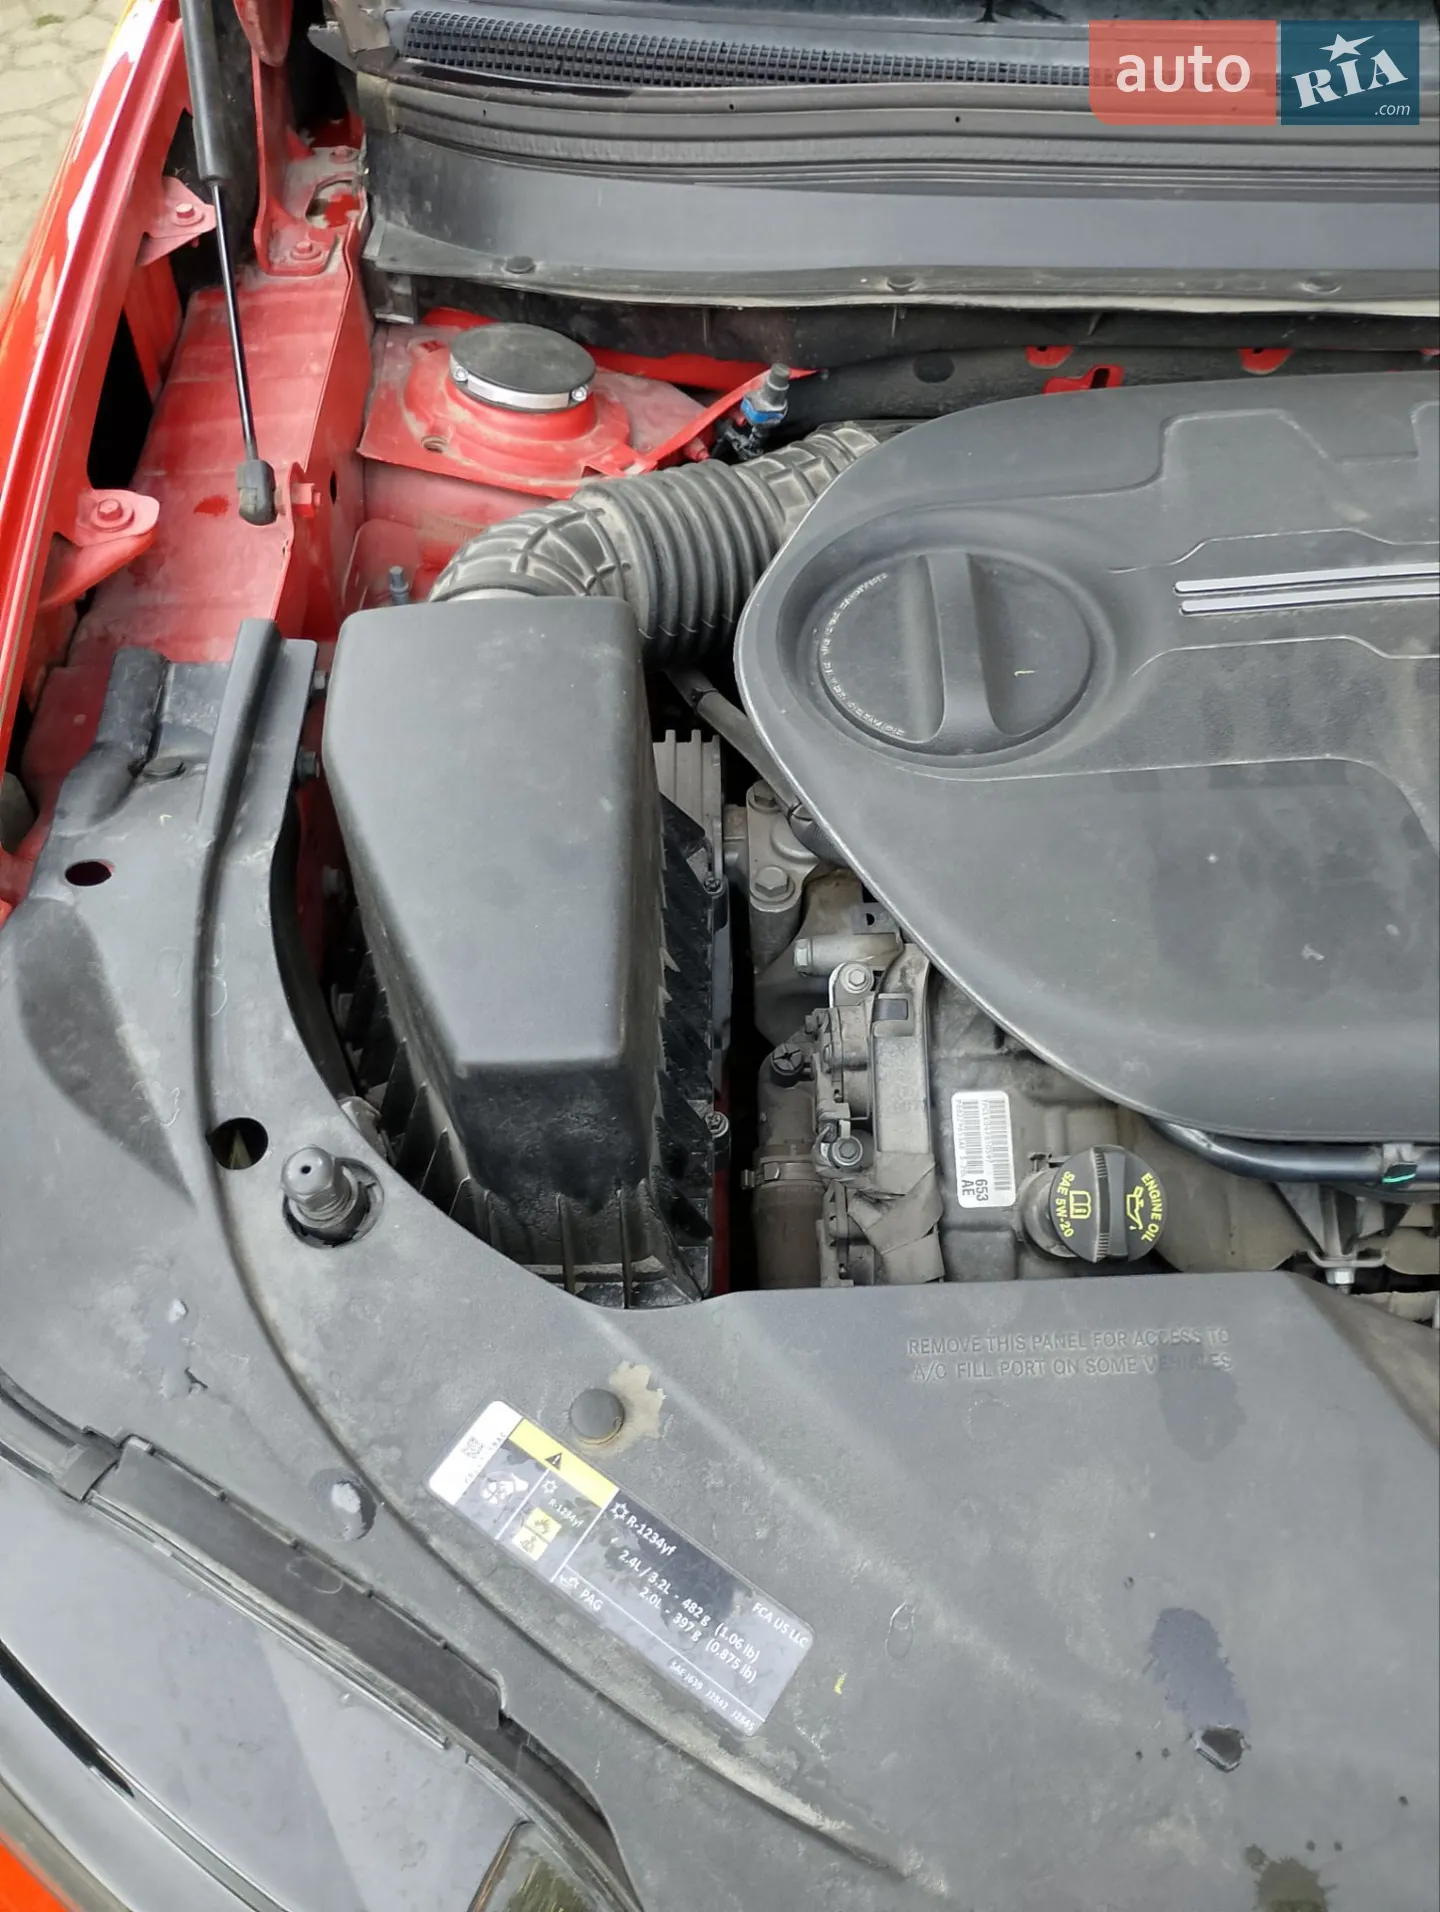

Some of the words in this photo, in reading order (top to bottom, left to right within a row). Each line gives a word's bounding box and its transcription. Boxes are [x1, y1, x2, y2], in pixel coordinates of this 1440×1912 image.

[961, 1179, 976, 1196] AE
[975, 1179, 989, 1202] 653
[1057, 1171, 1076, 1196] SAE
[1140, 1172, 1163, 1221] ENGINE
[1055, 1198, 1075, 1238] 5W-20
[1141, 1223, 1160, 1242] OIL
[908, 1336, 982, 1355] REMOVE
[986, 1334, 1026, 1353] THIS
[1031, 1331, 1087, 1351] PANEL
[1093, 1331, 1128, 1348] FOR
[1134, 1328, 1202, 1347] ACCESS
[1206, 1327, 1231, 1346] TO
[956, 1361, 993, 1379] FILL
[1000, 1359, 1046, 1377] PORT
[1053, 1358, 1080, 1376] ON
[1085, 1356, 1138, 1375] SOME
[626, 1515, 677, 1556] R-1234yf
[579, 1589, 604, 1611] PAG
[618, 1549, 641, 1572] 2.4L
[648, 1571, 671, 1595] 3.2L
[682, 1598, 704, 1619] 482
[700, 1615, 711, 1627] g
[715, 1622, 744, 1650] (1.06
[742, 1643, 760, 1664] lb)
[639, 1587, 662, 1609] 2.0L
[673, 1612, 695, 1632] 397
[691, 1630, 702, 1642] g
[705, 1638, 741, 1670] (0.875
[739, 1663, 757, 1684] lb)
[751, 1602, 773, 1623] FCA
[773, 1617, 790, 1633] US
[788, 1629, 809, 1648] LLC
